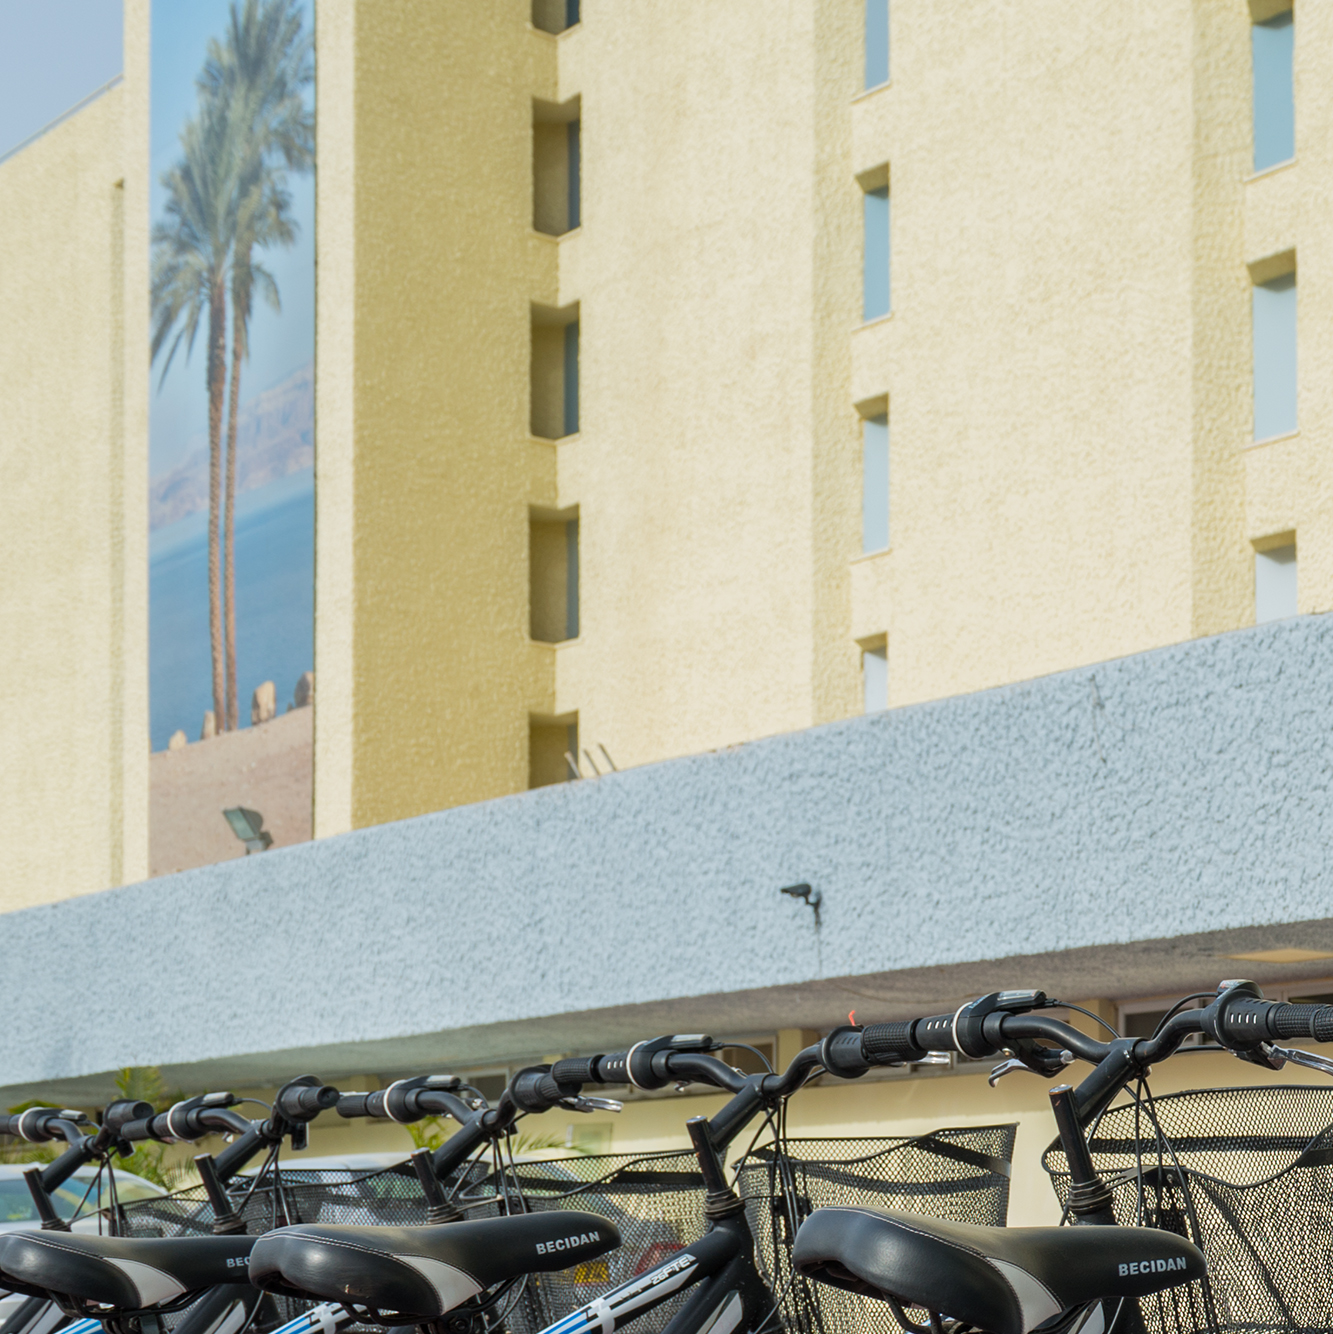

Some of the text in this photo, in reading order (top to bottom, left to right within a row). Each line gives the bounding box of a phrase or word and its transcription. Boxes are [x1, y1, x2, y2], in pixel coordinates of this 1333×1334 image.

[536, 1231, 600, 1255] BECIDAN
[650, 1256, 691, 1285] 26FTE
[1118, 1257, 1187, 1276] BECIDAN
